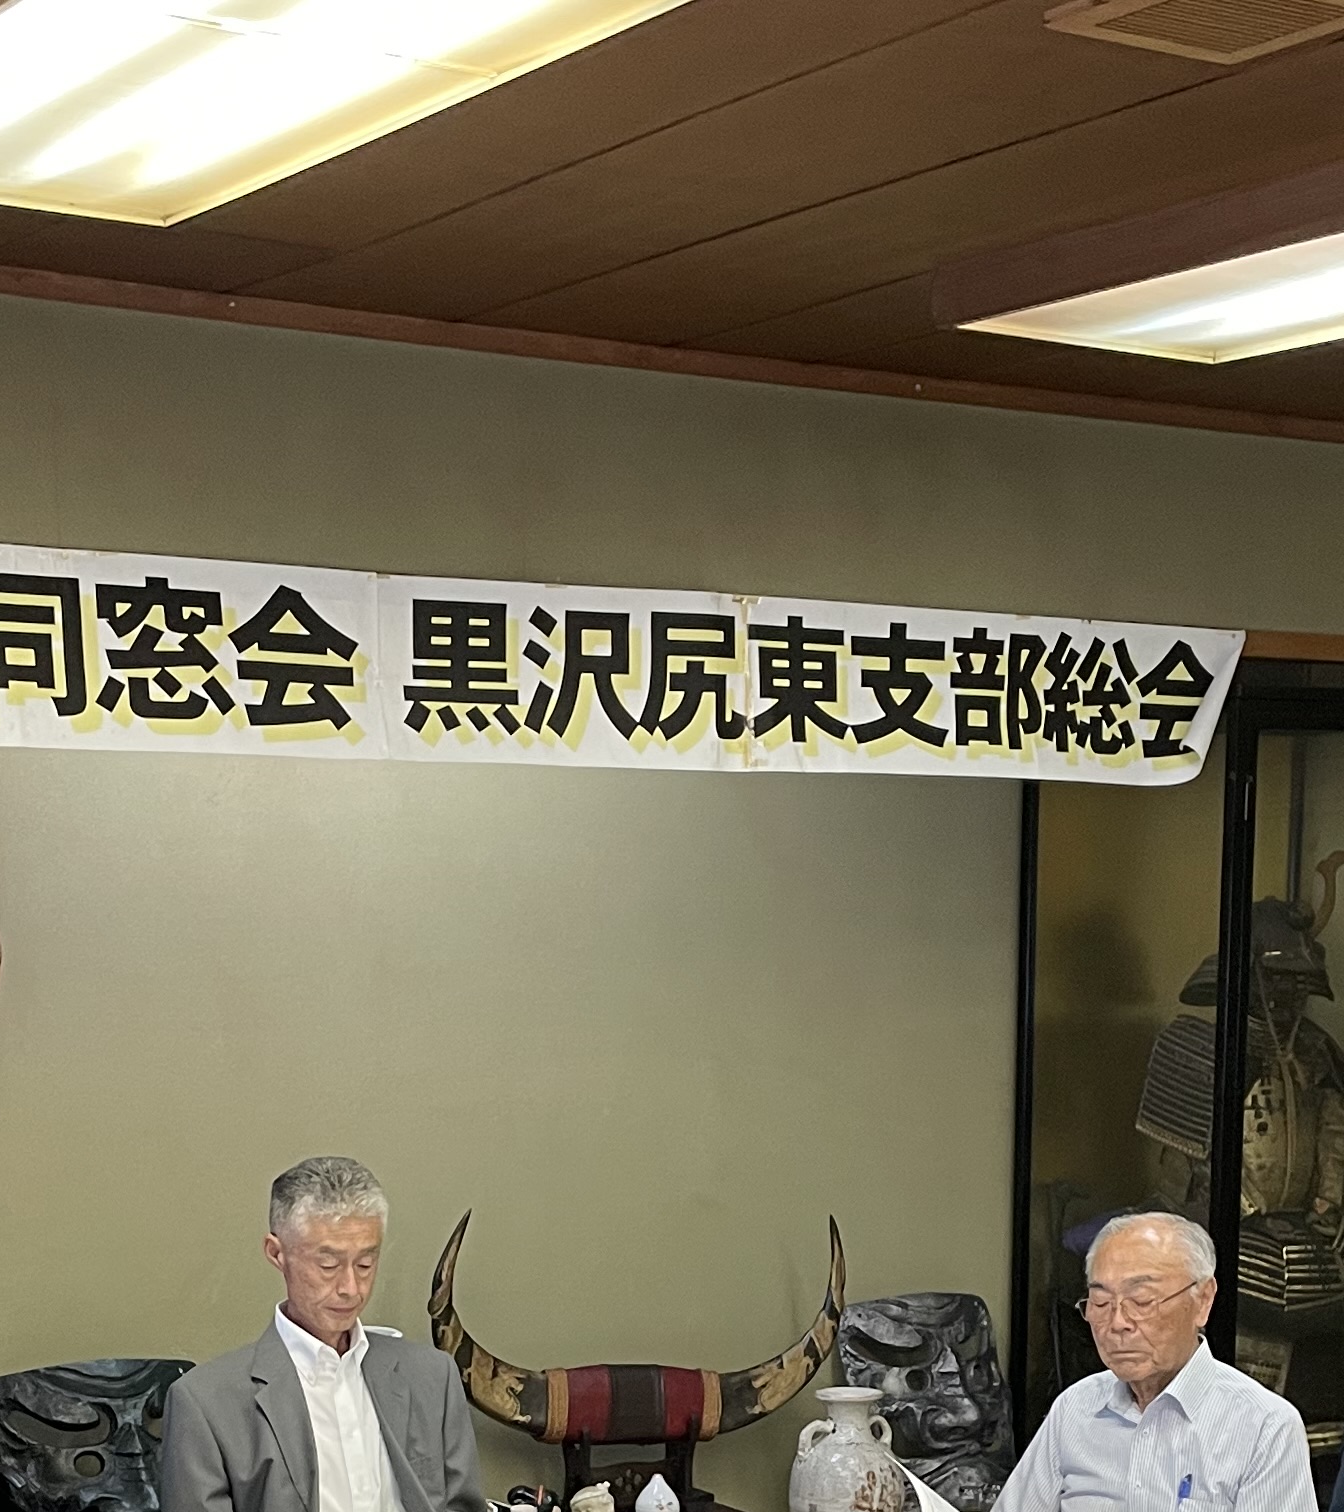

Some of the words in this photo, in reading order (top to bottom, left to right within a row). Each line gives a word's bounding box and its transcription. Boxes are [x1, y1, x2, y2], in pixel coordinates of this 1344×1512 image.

[403, 598, 1215, 759] 黒沢尻東支部総会
